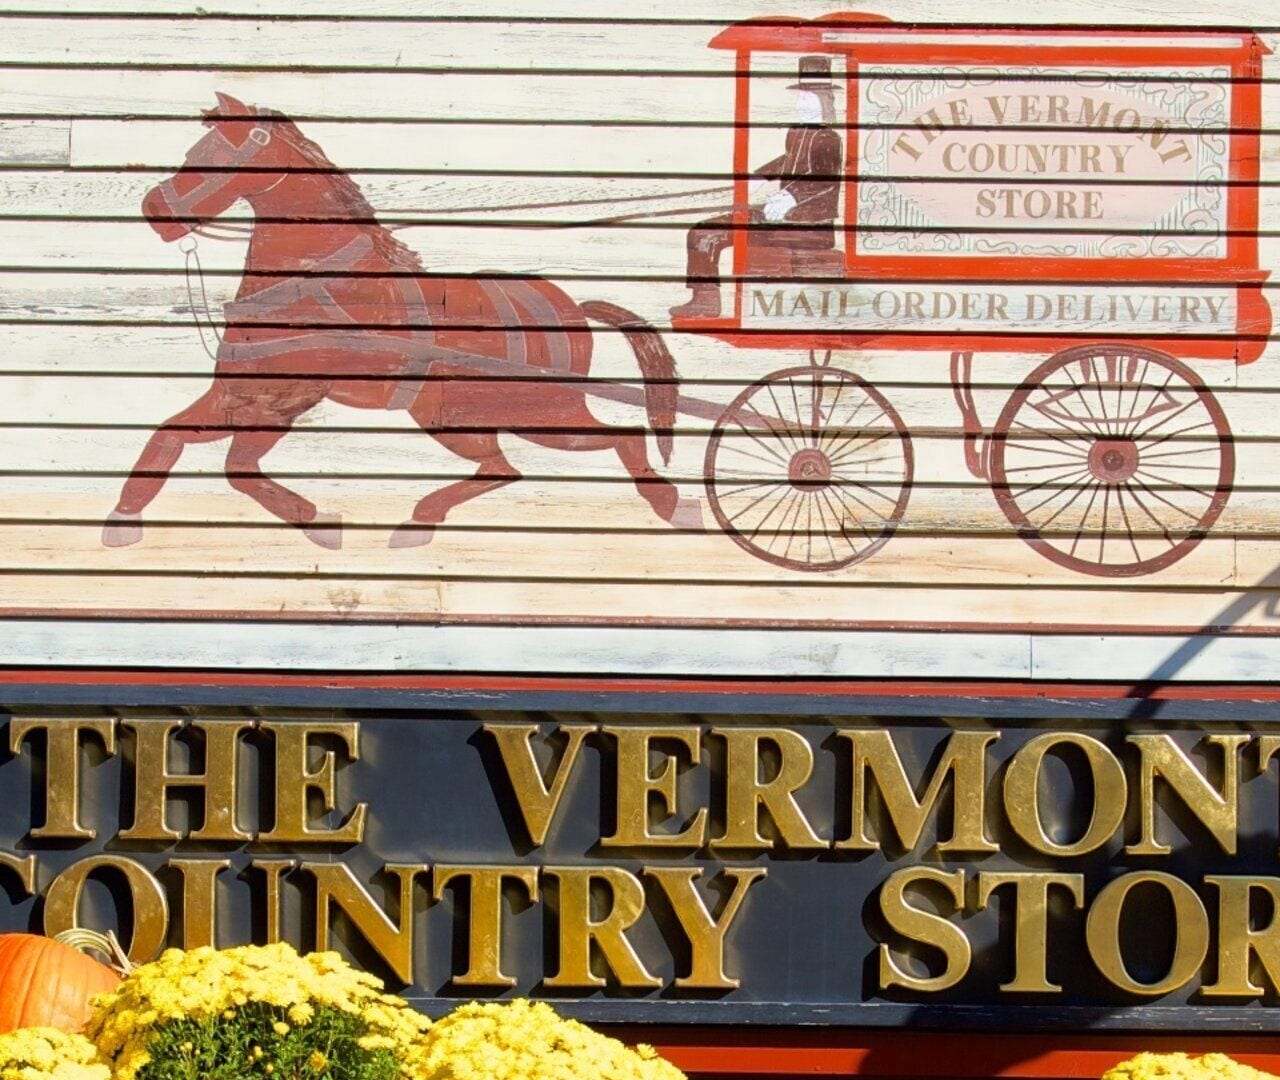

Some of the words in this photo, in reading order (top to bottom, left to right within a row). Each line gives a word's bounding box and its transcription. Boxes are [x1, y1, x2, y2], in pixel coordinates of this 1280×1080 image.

[891, 98, 973, 162] THE
[984, 94, 1193, 166] VERMONT
[941, 141, 1134, 174] COUNTRY
[975, 188, 1104, 219] STORE
[750, 289, 861, 319] MAIL
[872, 289, 1011, 322] ORDER
[1026, 292, 1229, 325] DELIVERY
[8, 717, 368, 843] THE
